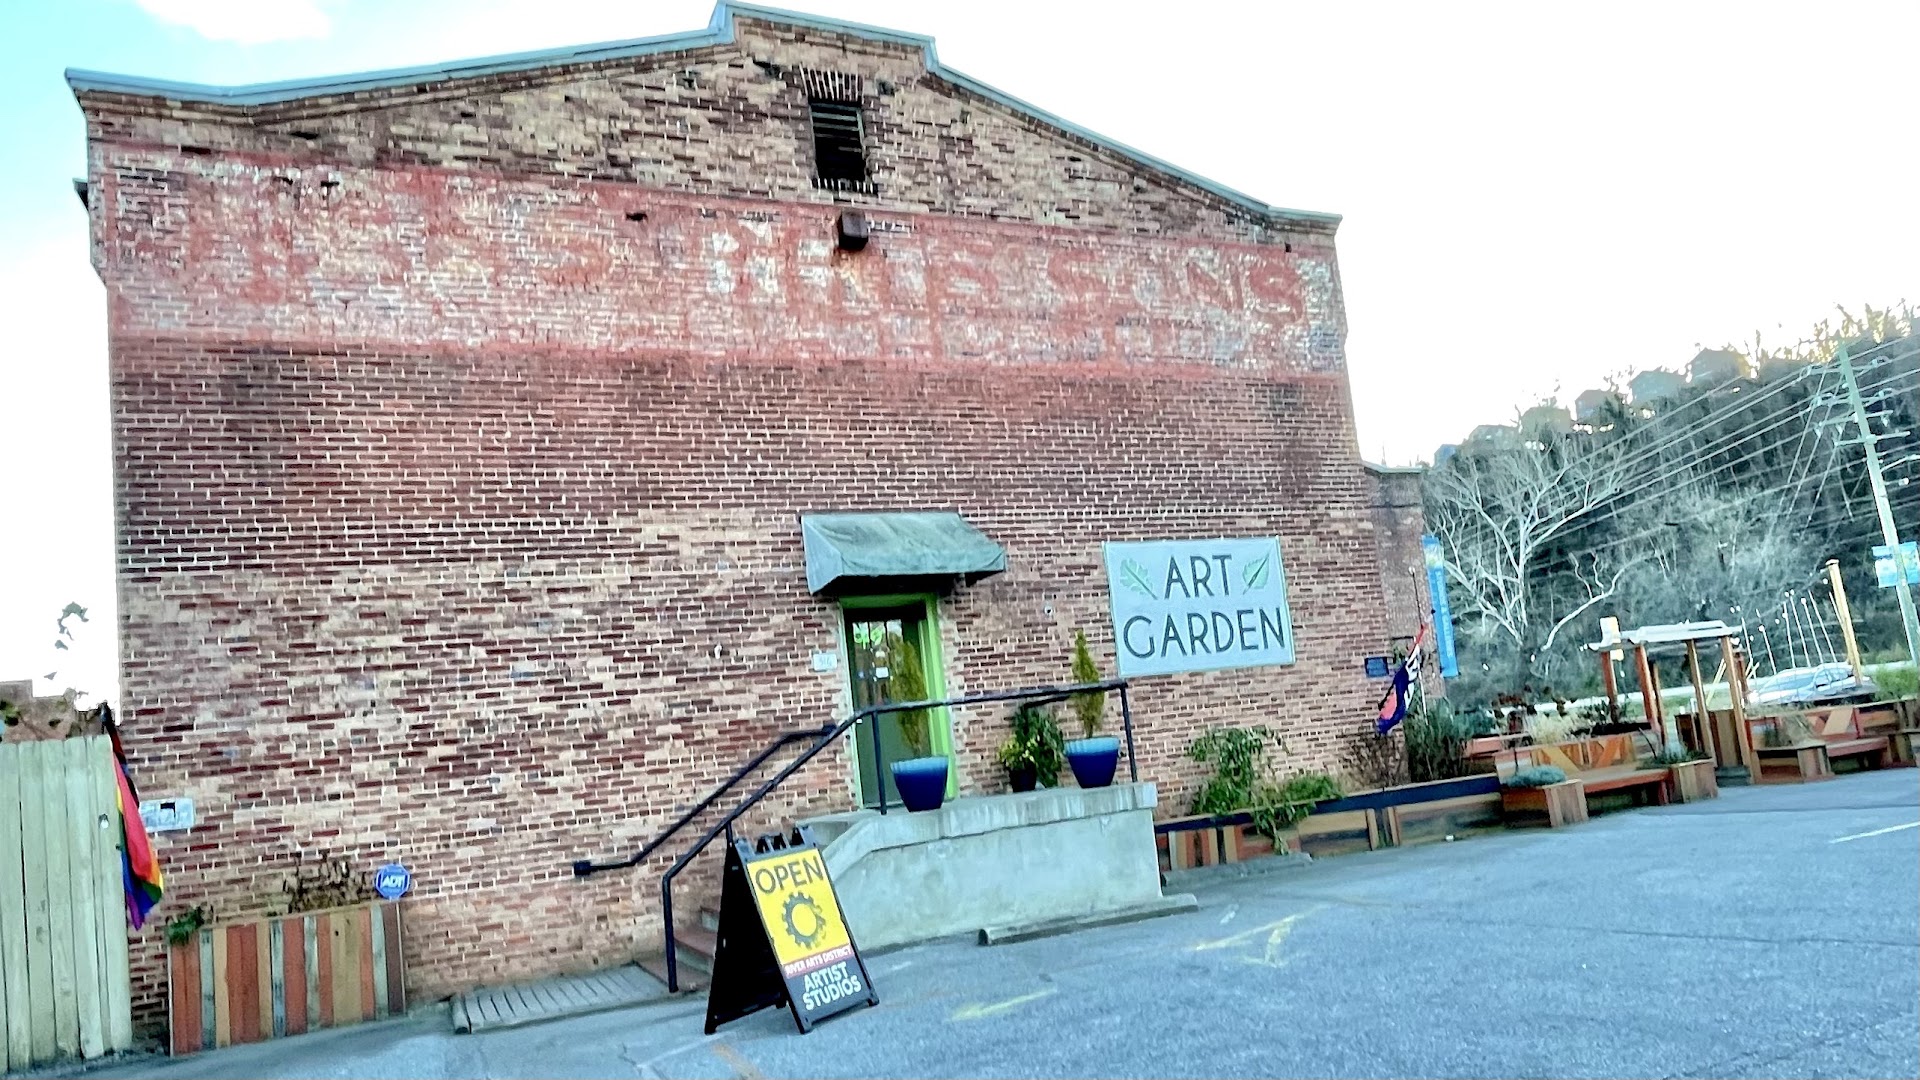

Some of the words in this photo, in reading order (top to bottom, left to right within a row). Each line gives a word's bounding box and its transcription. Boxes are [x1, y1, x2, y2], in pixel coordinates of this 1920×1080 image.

[1164, 554, 1232, 600] ART
[1123, 607, 1285, 659] GARDEN
[382, 875, 405, 888] ADT
[755, 856, 823, 893] OPEN
[784, 960, 806, 975] RIVER
[806, 954, 823, 968] ARTS
[822, 945, 852, 962] DISTRICT
[804, 961, 848, 992] ARTIST
[803, 975, 862, 1011] STUDIOS
